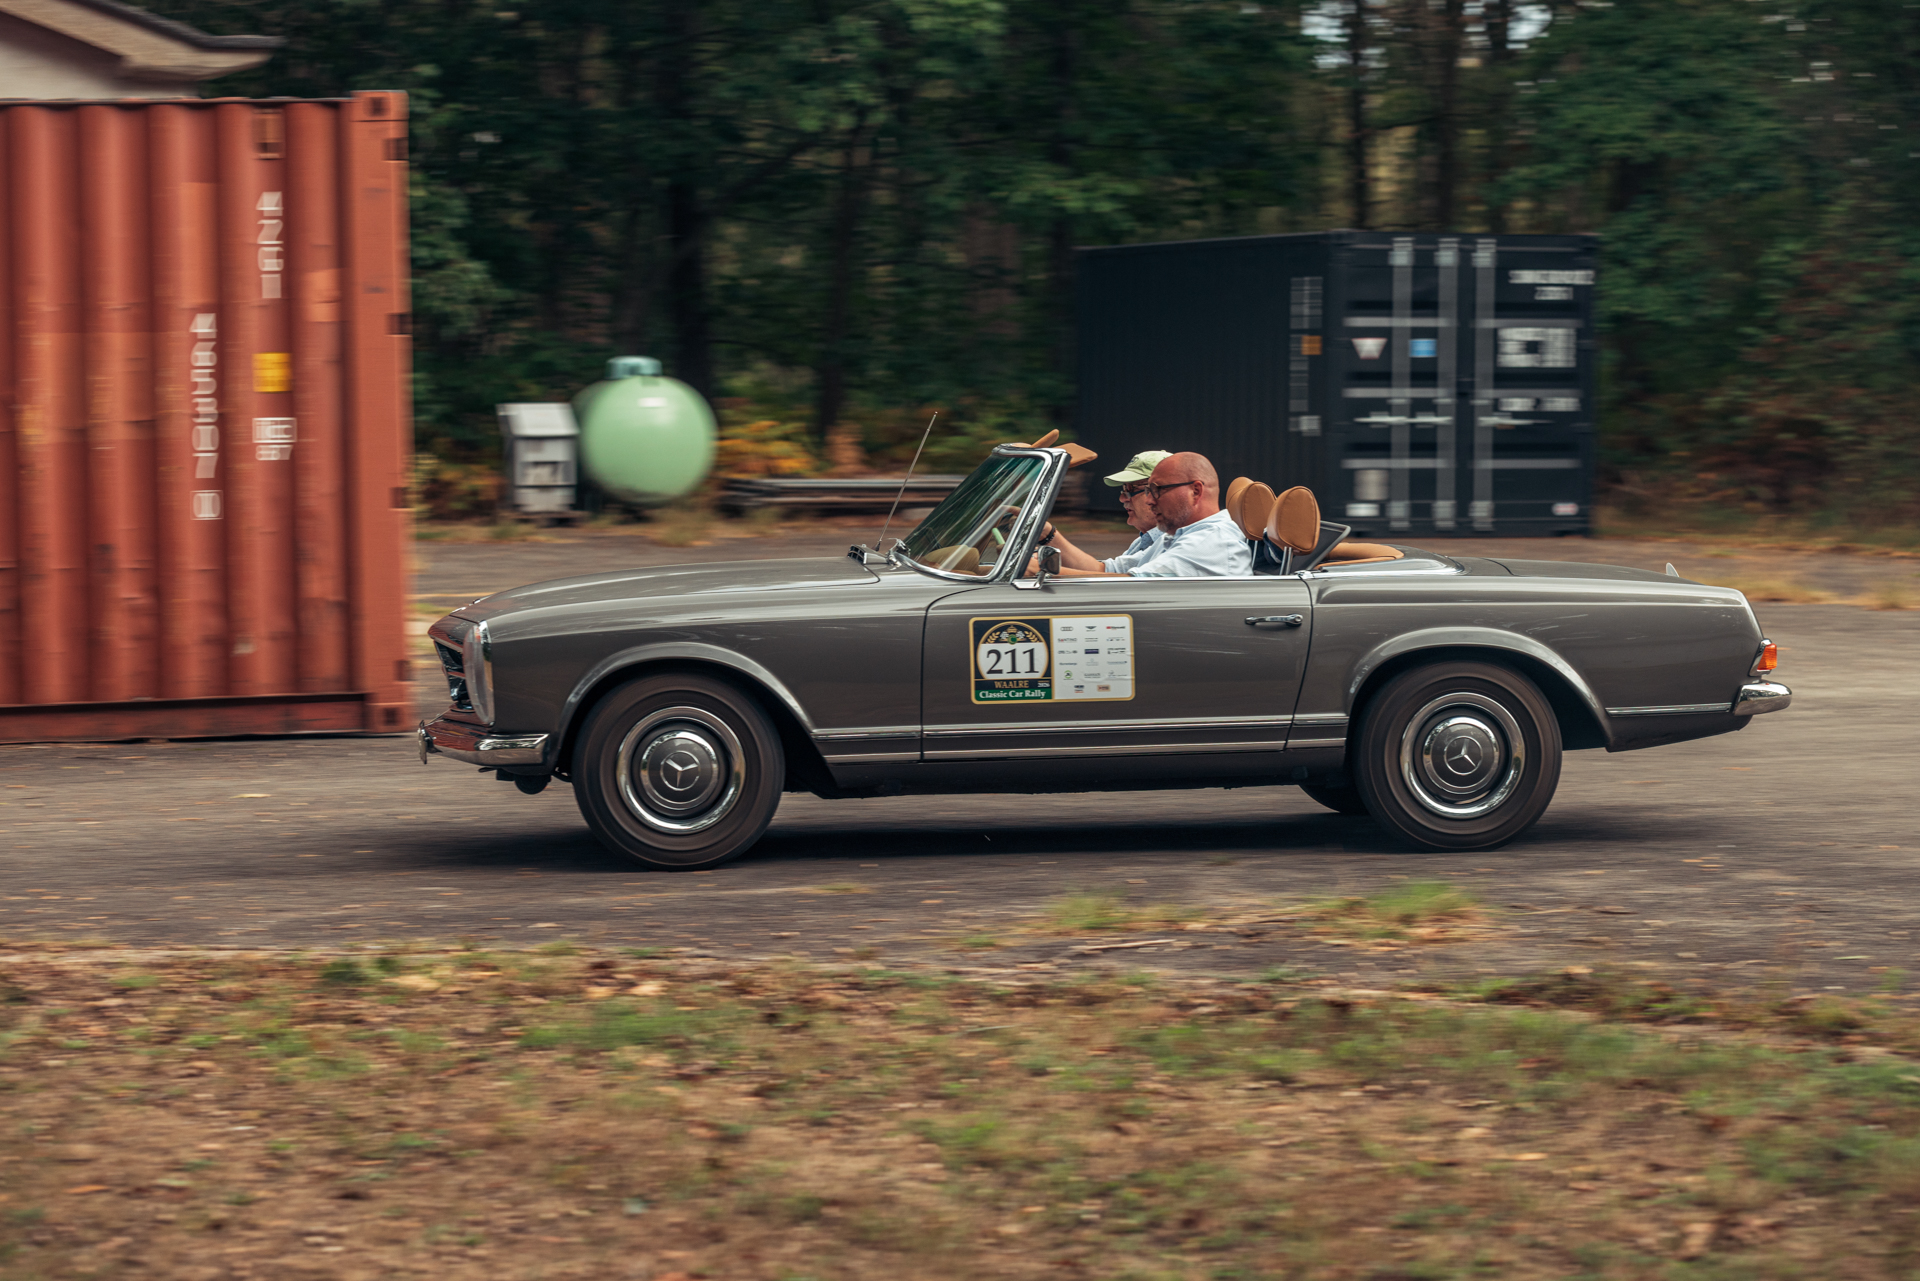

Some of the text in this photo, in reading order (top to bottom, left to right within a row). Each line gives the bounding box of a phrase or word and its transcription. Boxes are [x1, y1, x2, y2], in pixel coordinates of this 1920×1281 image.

[255, 191, 284, 299] 42G1
[986, 647, 1040, 675] 211
[979, 689, 1046, 699] Classic Car Rally
[994, 680, 1030, 689] WAALRE
